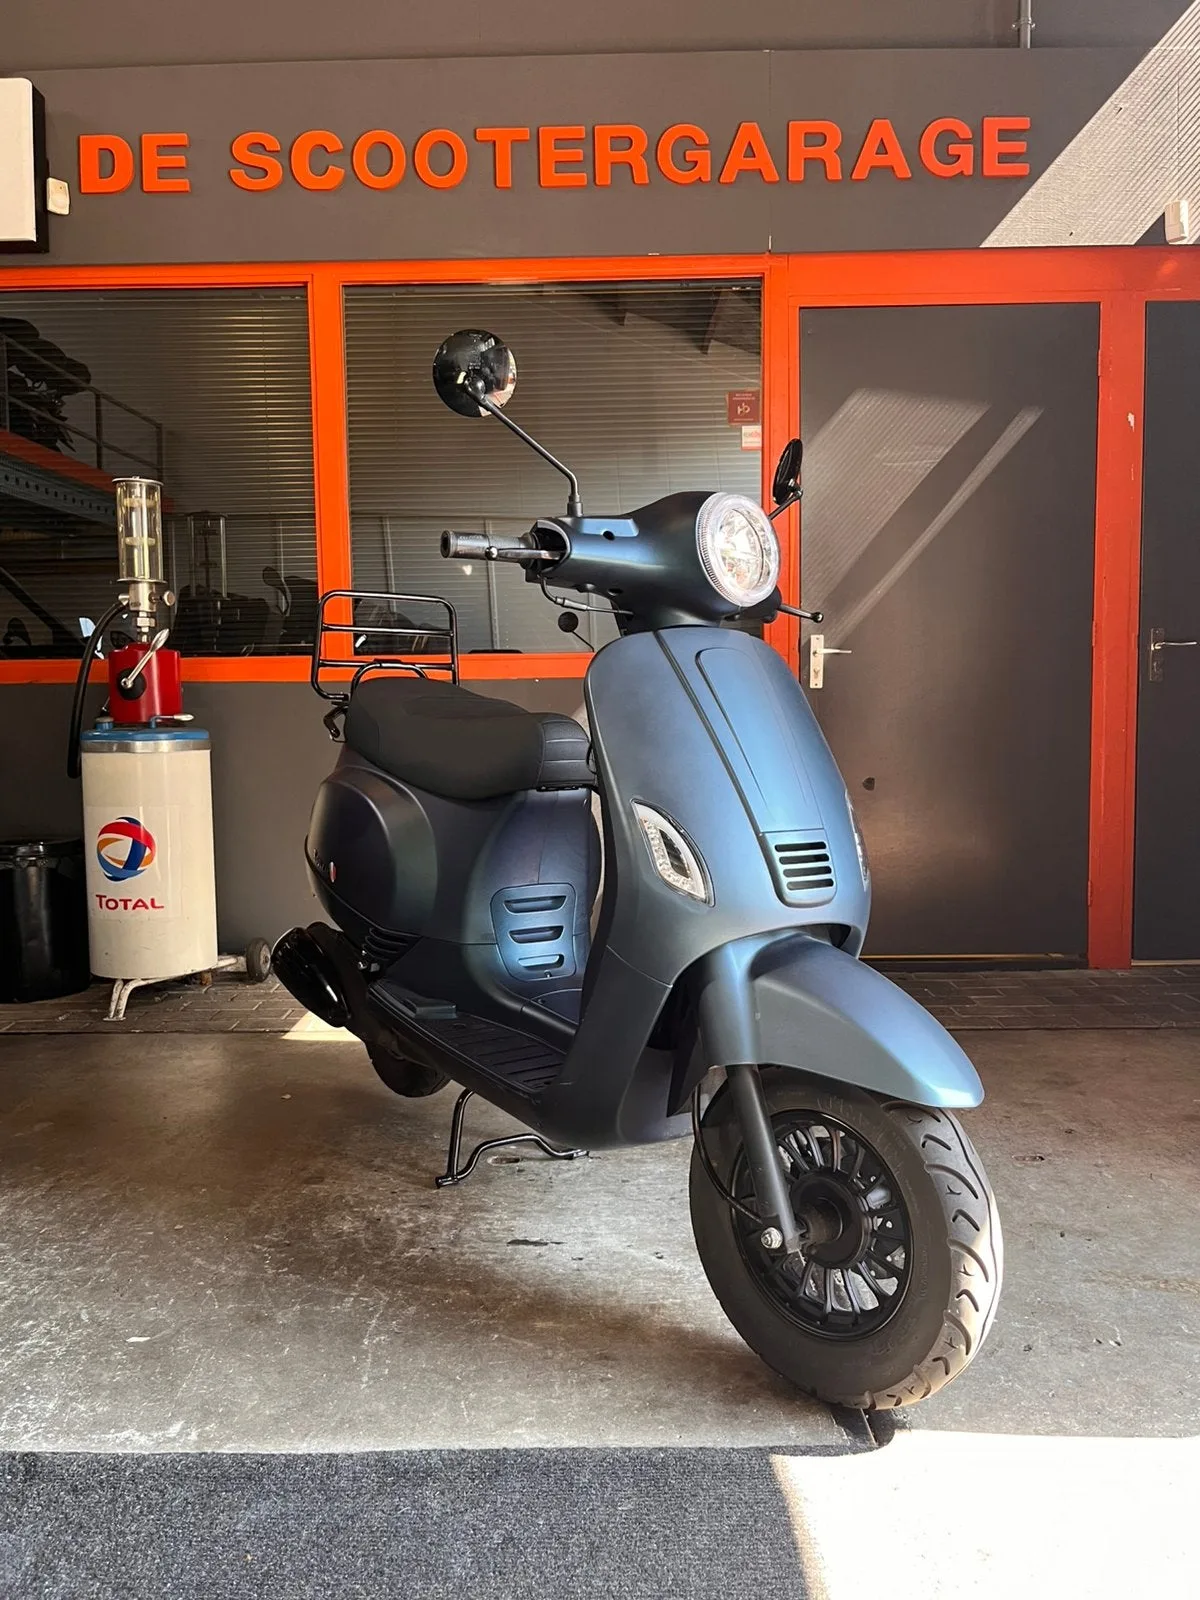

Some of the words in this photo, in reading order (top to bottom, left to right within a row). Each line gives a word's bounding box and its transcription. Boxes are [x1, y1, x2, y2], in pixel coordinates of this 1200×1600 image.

[79, 132, 191, 194] DE
[229, 116, 1031, 192] SCOOTERGARAGE
[95, 894, 164, 911] TOTAL
